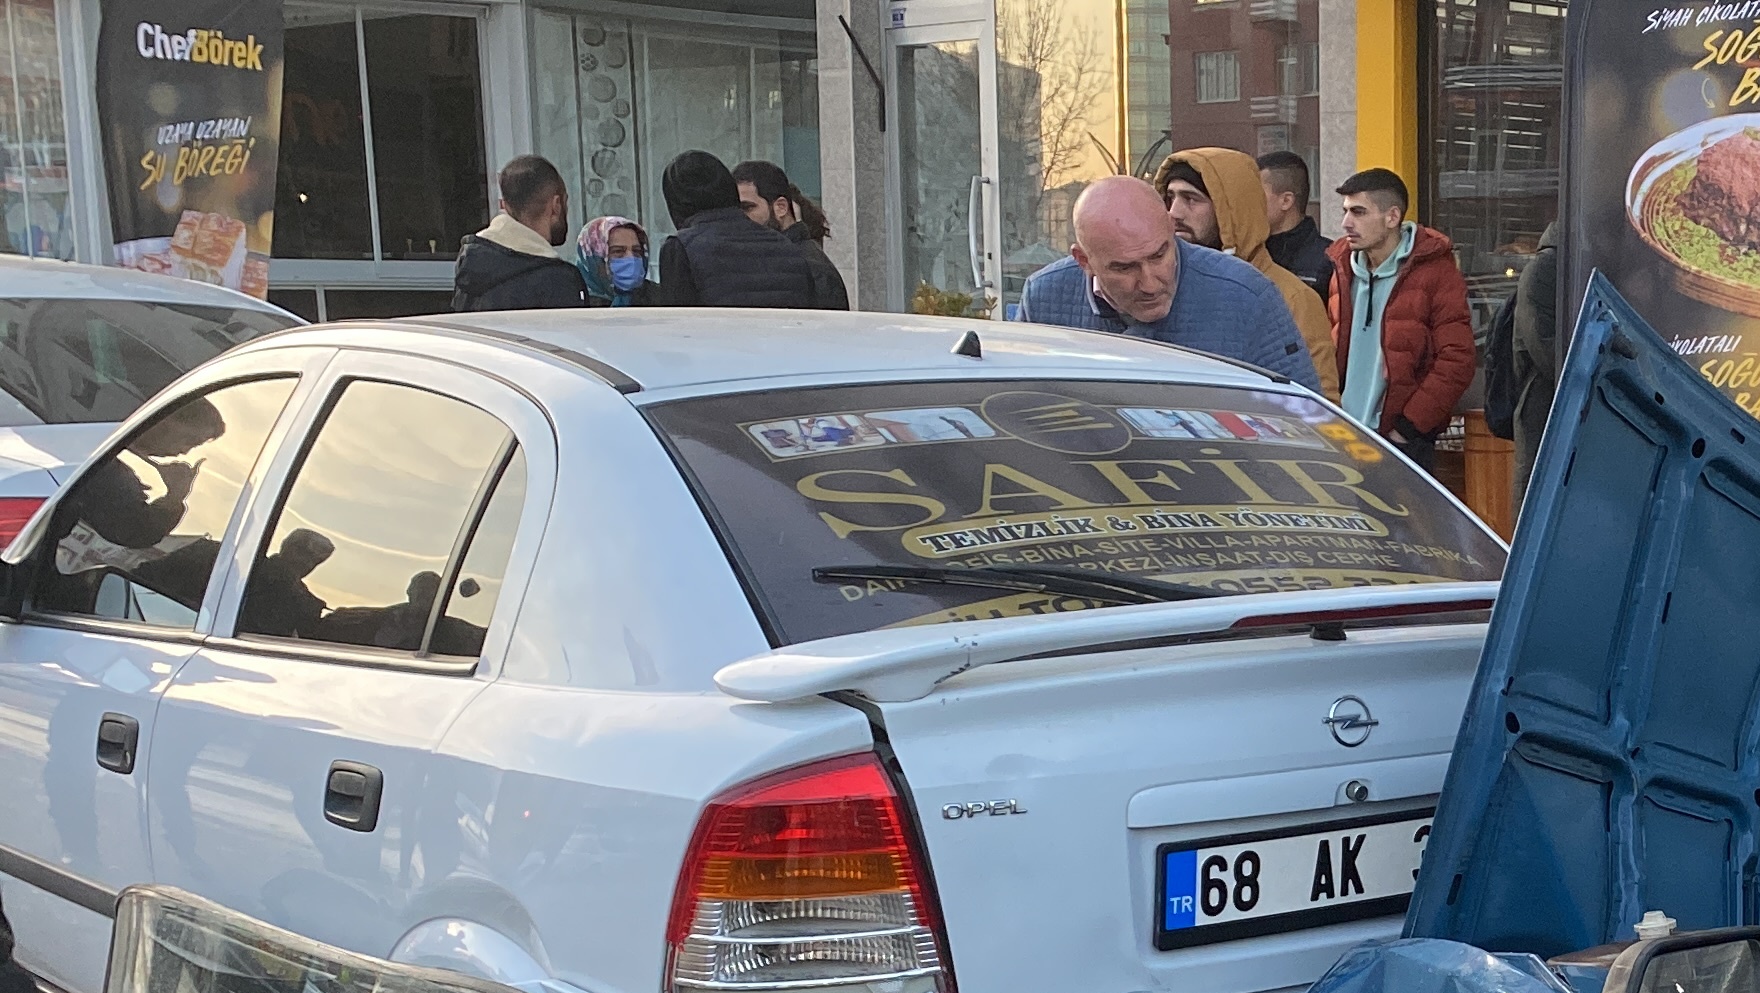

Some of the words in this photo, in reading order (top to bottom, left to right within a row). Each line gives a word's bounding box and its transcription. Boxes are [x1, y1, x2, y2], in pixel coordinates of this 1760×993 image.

[1642, 8, 1695, 33] SİYAH
[137, 22, 263, 71] ChefBörek
[140, 150, 167, 191] SU
[173, 137, 256, 186] BÖREĞİ
[1668, 334, 1742, 356] İKOLATALI
[796, 448, 1409, 539] SAFİR
[919, 514, 1105, 553] TEMİZLİK
[1106, 515, 1137, 532] &
[1139, 509, 1223, 531] BİNA
[1317, 550, 1401, 568] CEPHE
[942, 798, 1028, 820] OPEL
[1170, 895, 1193, 915] TR
[1200, 850, 1261, 917] 68
[1310, 833, 1367, 902] AK
